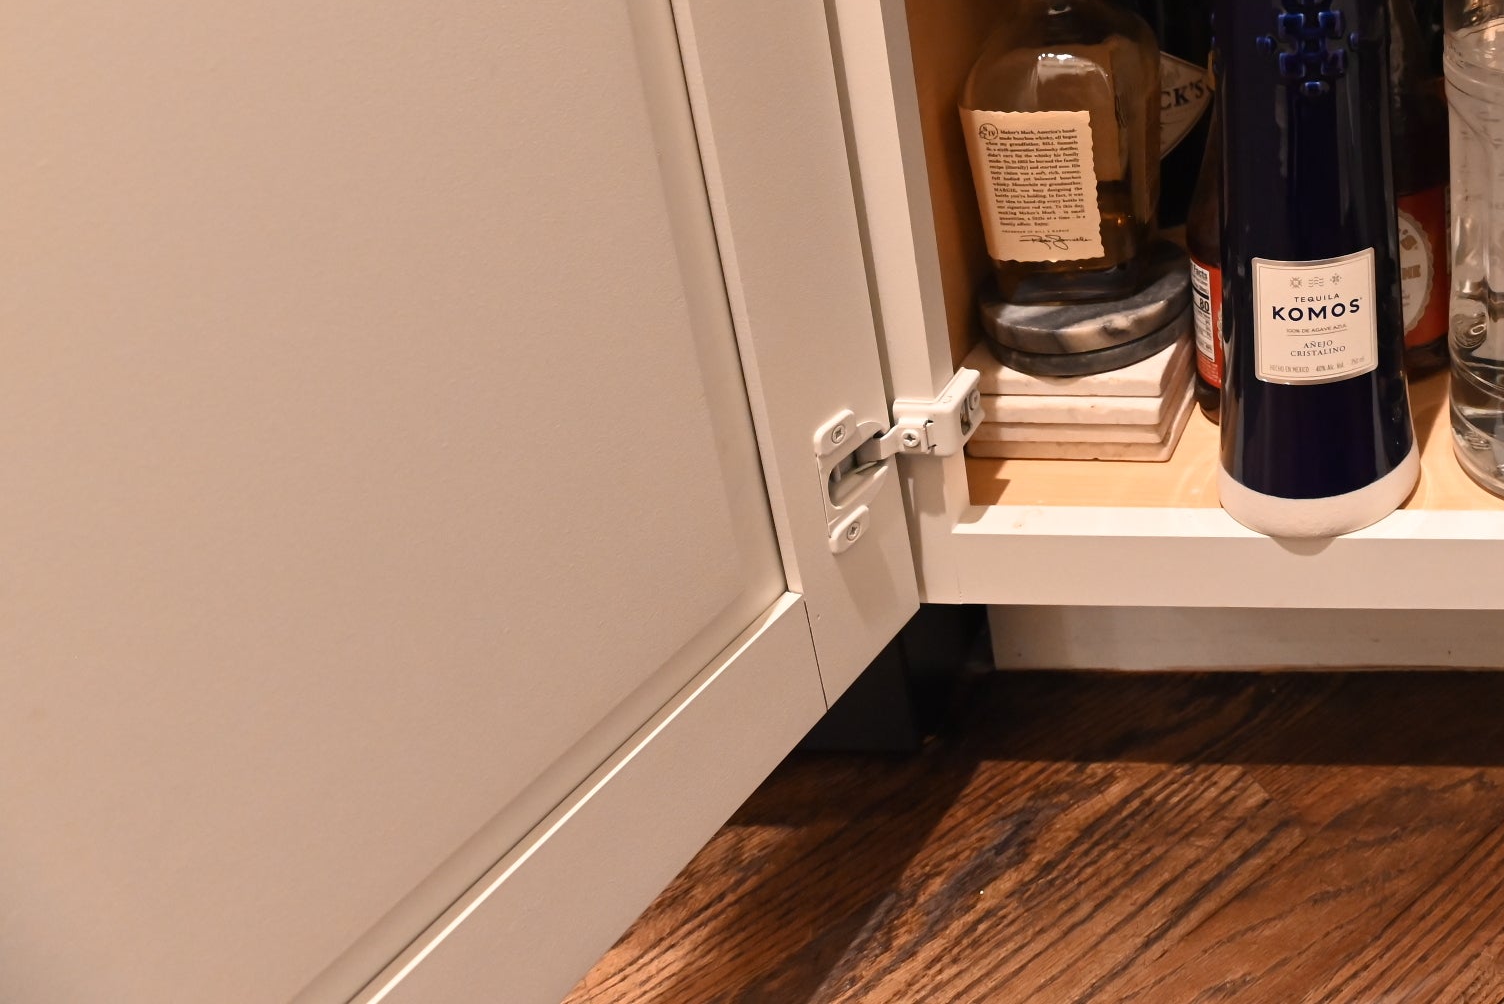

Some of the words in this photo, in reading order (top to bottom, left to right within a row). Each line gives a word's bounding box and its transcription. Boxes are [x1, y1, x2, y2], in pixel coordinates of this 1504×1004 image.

[1294, 293, 1340, 303] TEQUILA
[1200, 298, 1209, 311] 80
[1272, 298, 1360, 321] KOMOS
[1304, 339, 1333, 349] AÑEJO
[1291, 346, 1346, 357] CRISTALINO
